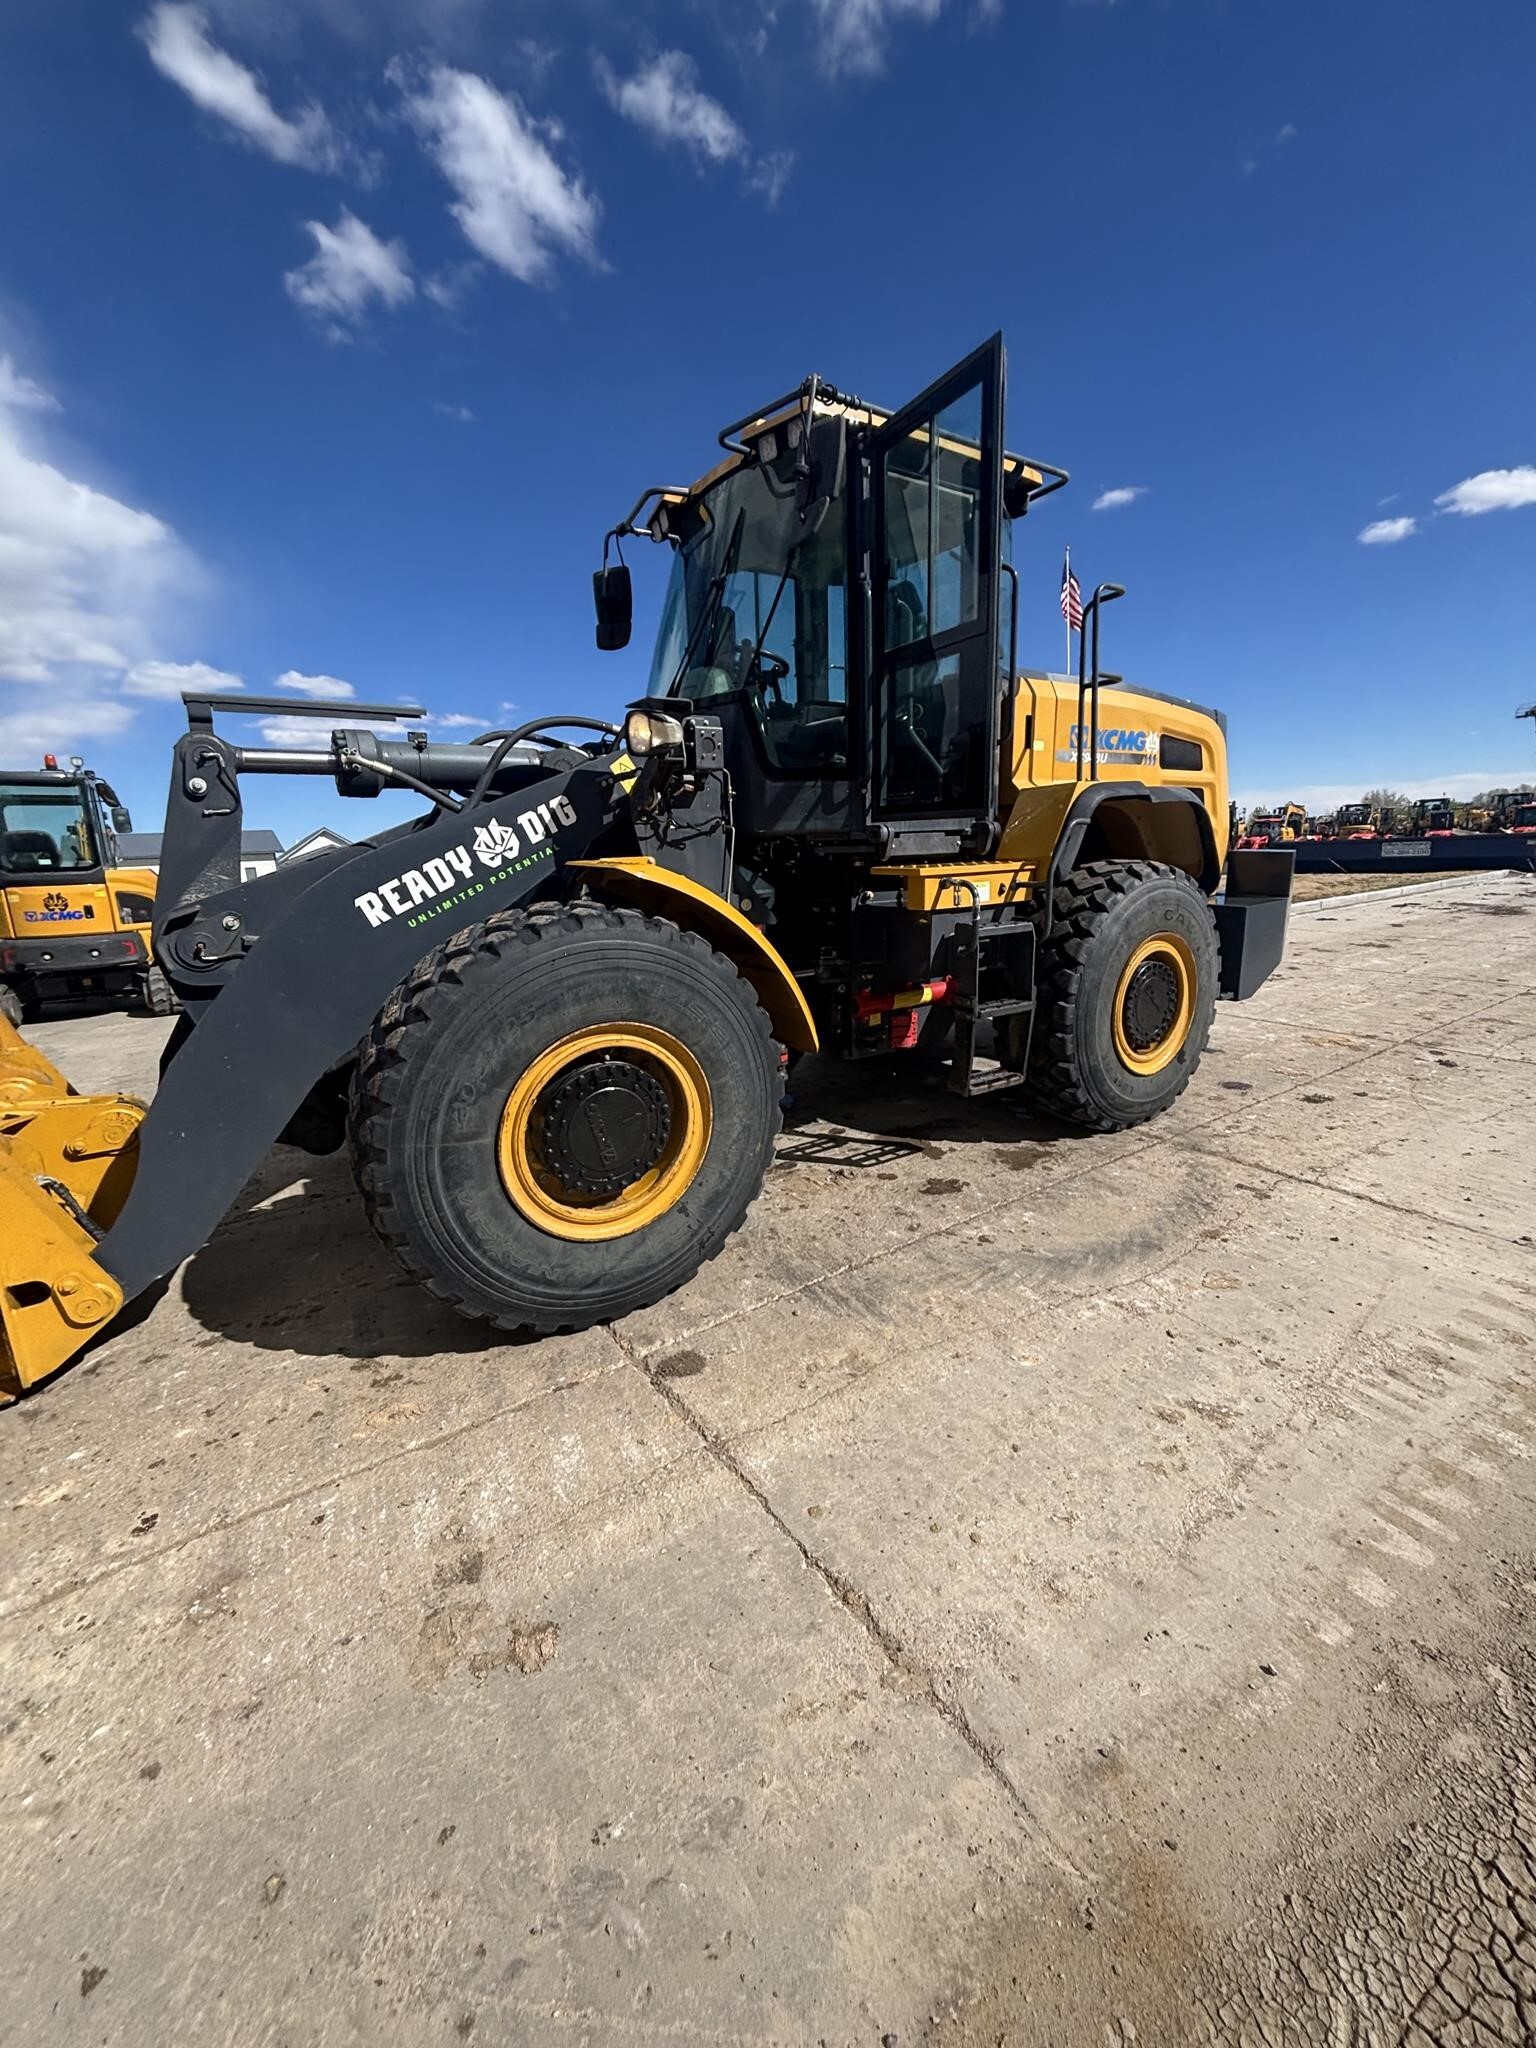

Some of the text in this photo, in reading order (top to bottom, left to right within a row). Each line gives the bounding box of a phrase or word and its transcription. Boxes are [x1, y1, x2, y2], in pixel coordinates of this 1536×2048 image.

[354, 795, 578, 928] READY DIG
[407, 844, 561, 928] UNLIMITED POTENTIAL
[39, 911, 83, 921] XCMG
